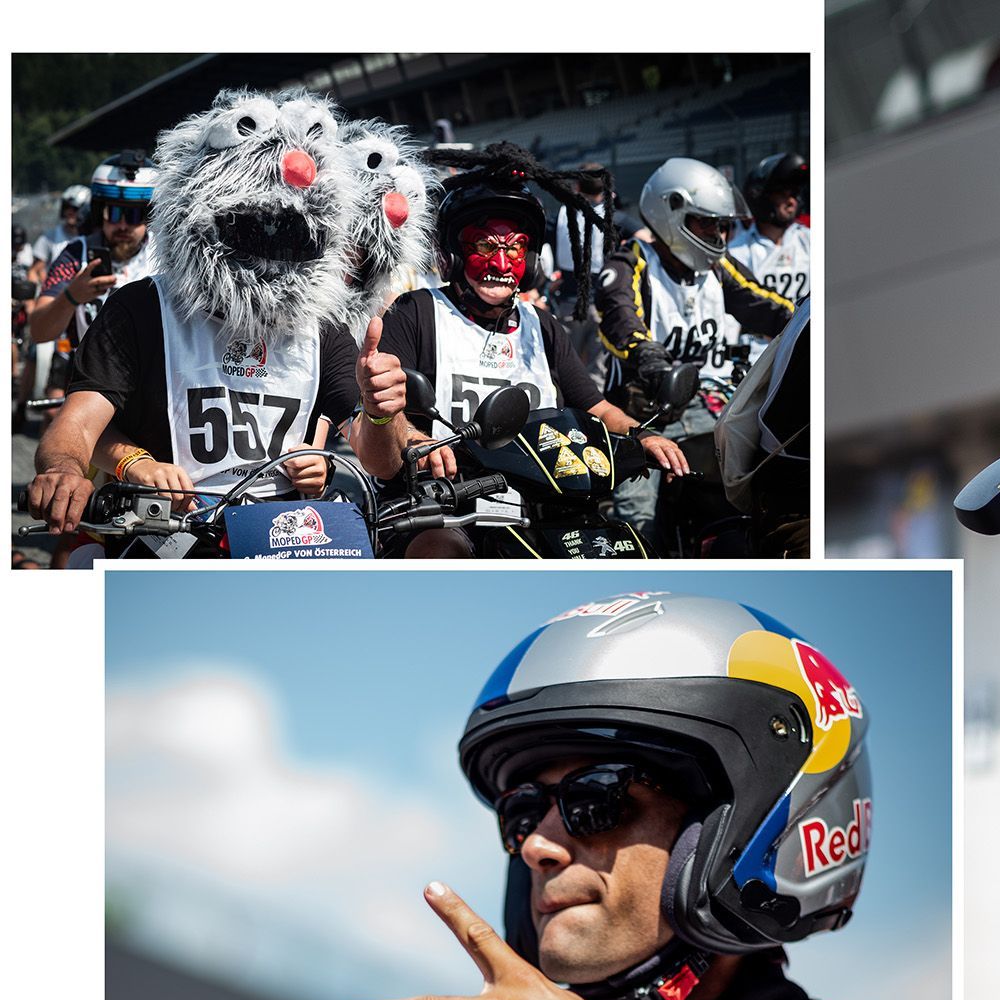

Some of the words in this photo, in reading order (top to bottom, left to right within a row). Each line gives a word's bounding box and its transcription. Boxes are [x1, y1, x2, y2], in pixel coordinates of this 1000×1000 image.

[222, 364, 245, 377] MOPED
[246, 367, 255, 378] GP
[187, 386, 301, 464] 557
[272, 536, 301, 547] MOPED
[302, 535, 313, 544] GP
[562, 530, 580, 540] 46
[564, 538, 583, 548] THANK
[614, 540, 635, 552] 46
[293, 549, 313, 557] VON
[314, 547, 361, 557] ÖSTERREICH
[799, 799, 861, 877] Red
